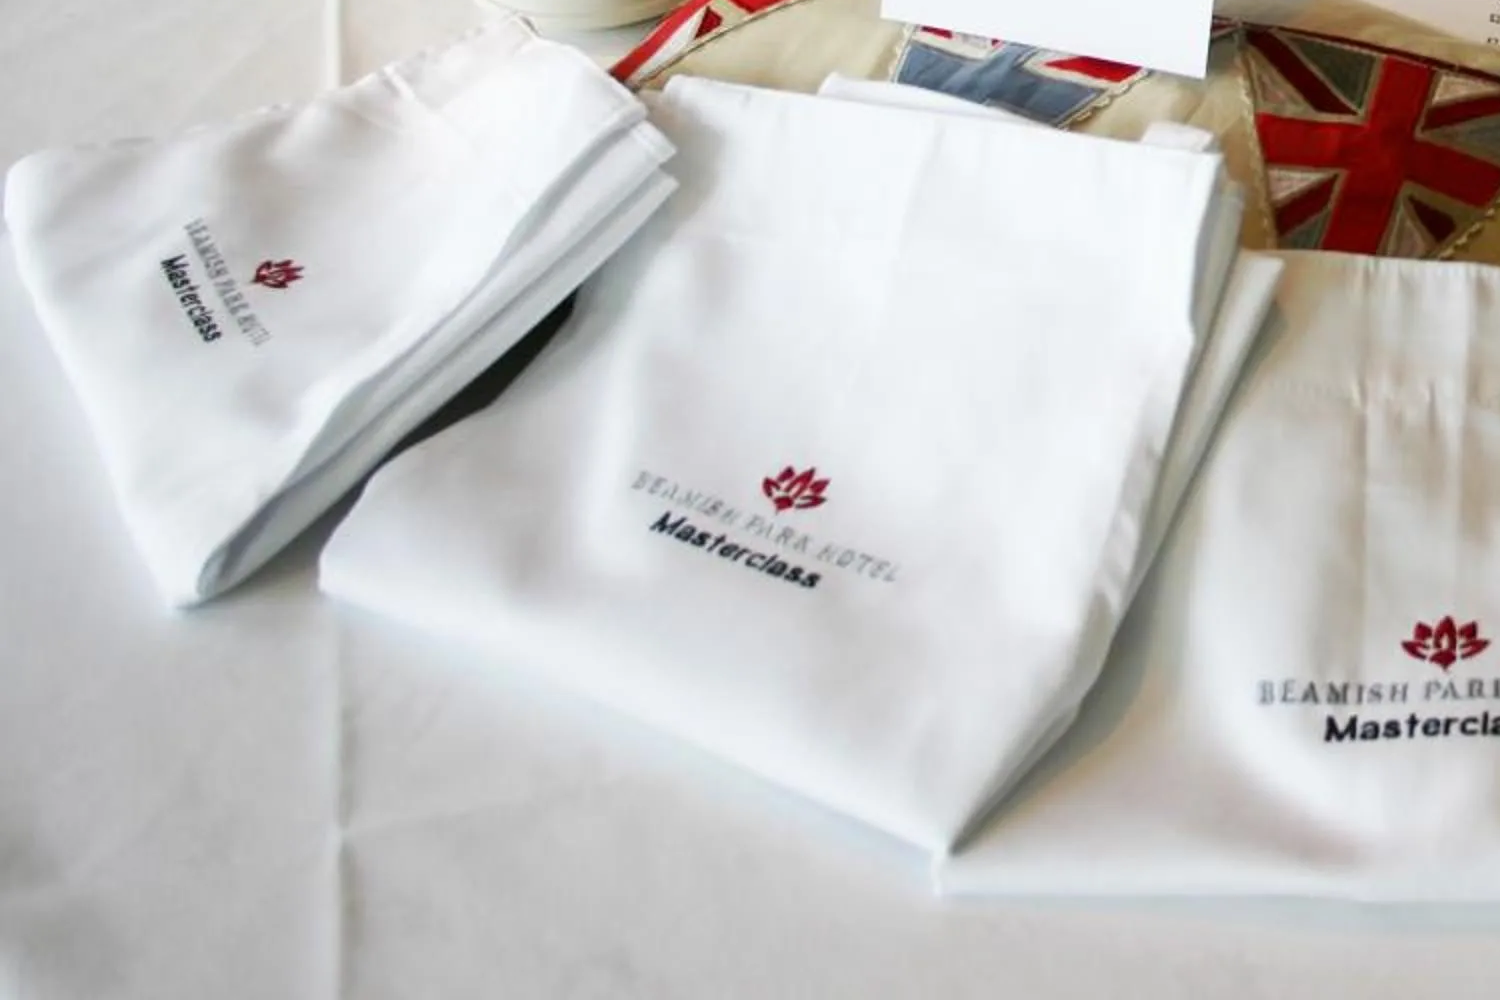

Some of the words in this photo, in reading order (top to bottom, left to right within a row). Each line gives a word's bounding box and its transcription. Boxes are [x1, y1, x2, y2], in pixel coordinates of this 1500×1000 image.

[160, 253, 223, 343] Masterclass
[631, 470, 741, 528] BEAMISH
[745, 513, 813, 553] PARK
[816, 544, 901, 583] HOTEL
[649, 510, 823, 589] Masterclass
[1255, 679, 1409, 705] BEAMISH
